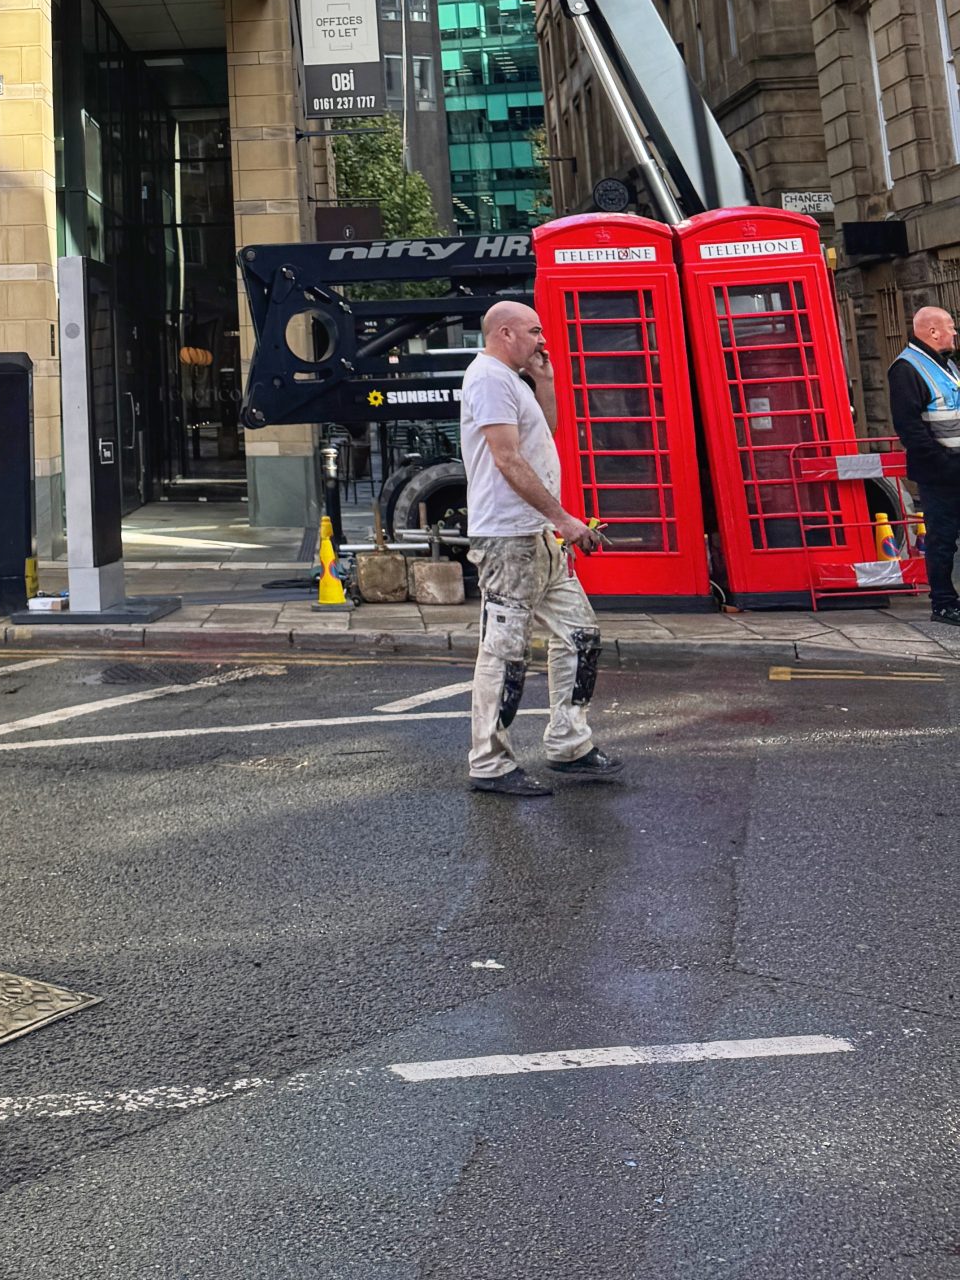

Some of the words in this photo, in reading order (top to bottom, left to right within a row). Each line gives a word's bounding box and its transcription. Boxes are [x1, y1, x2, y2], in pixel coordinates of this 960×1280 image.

[316, 16, 363, 27] OFFICES
[322, 29, 335, 38] TO
[338, 28, 359, 37] LET
[313, 98, 334, 110] 0161
[337, 97, 353, 109] 237
[356, 96, 376, 108] 1717
[796, 203, 822, 212] ANE
[329, 239, 466, 261] nifty
[474, 235, 536, 258] HR
[559, 248, 652, 262] TELEPHONE
[704, 240, 800, 257] TELEPHONE
[387, 389, 450, 404] SUNBELT
